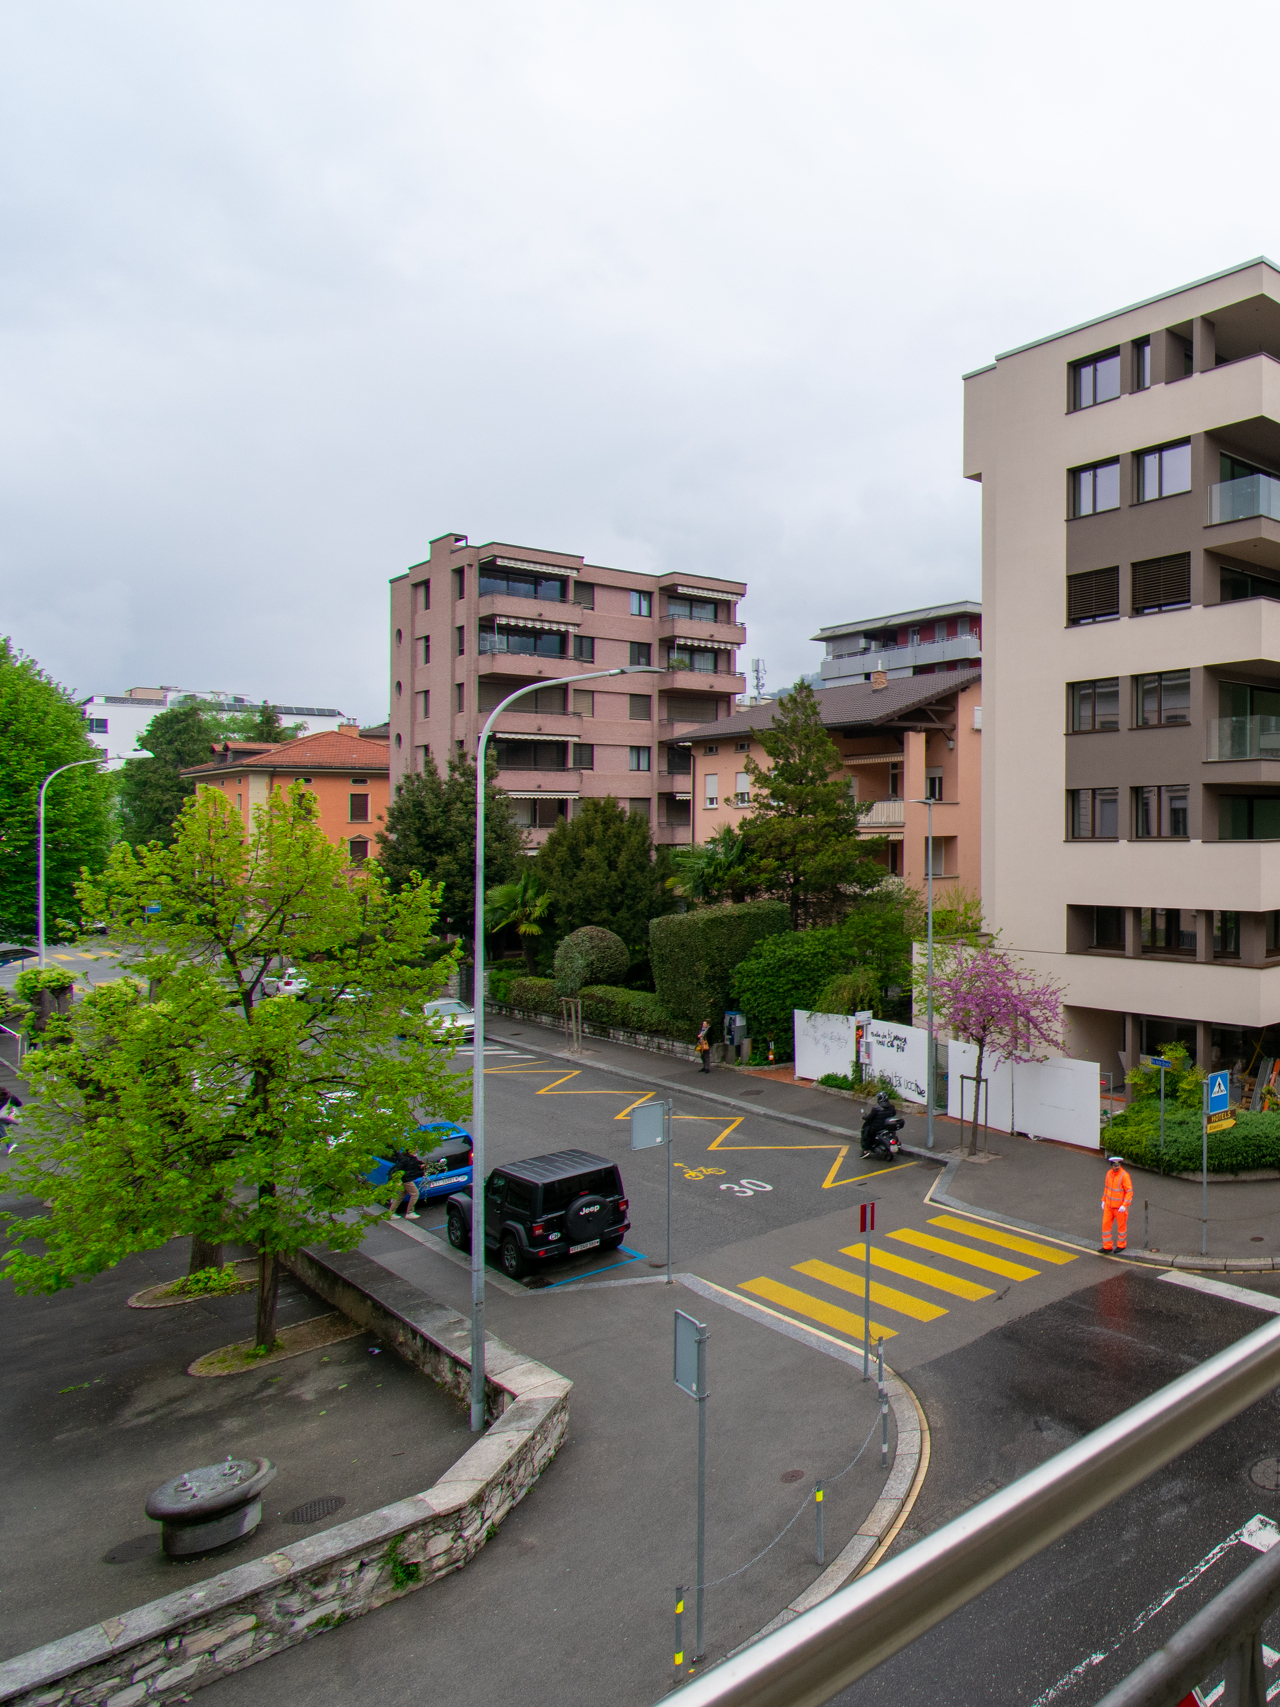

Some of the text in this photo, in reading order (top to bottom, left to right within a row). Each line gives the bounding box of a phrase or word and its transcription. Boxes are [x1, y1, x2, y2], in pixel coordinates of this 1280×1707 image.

[1211, 1111, 1231, 1122] HOTELS
[719, 1178, 773, 1197] 30
[579, 1204, 600, 1216] Jeep
[550, 1232, 560, 1240] CH
